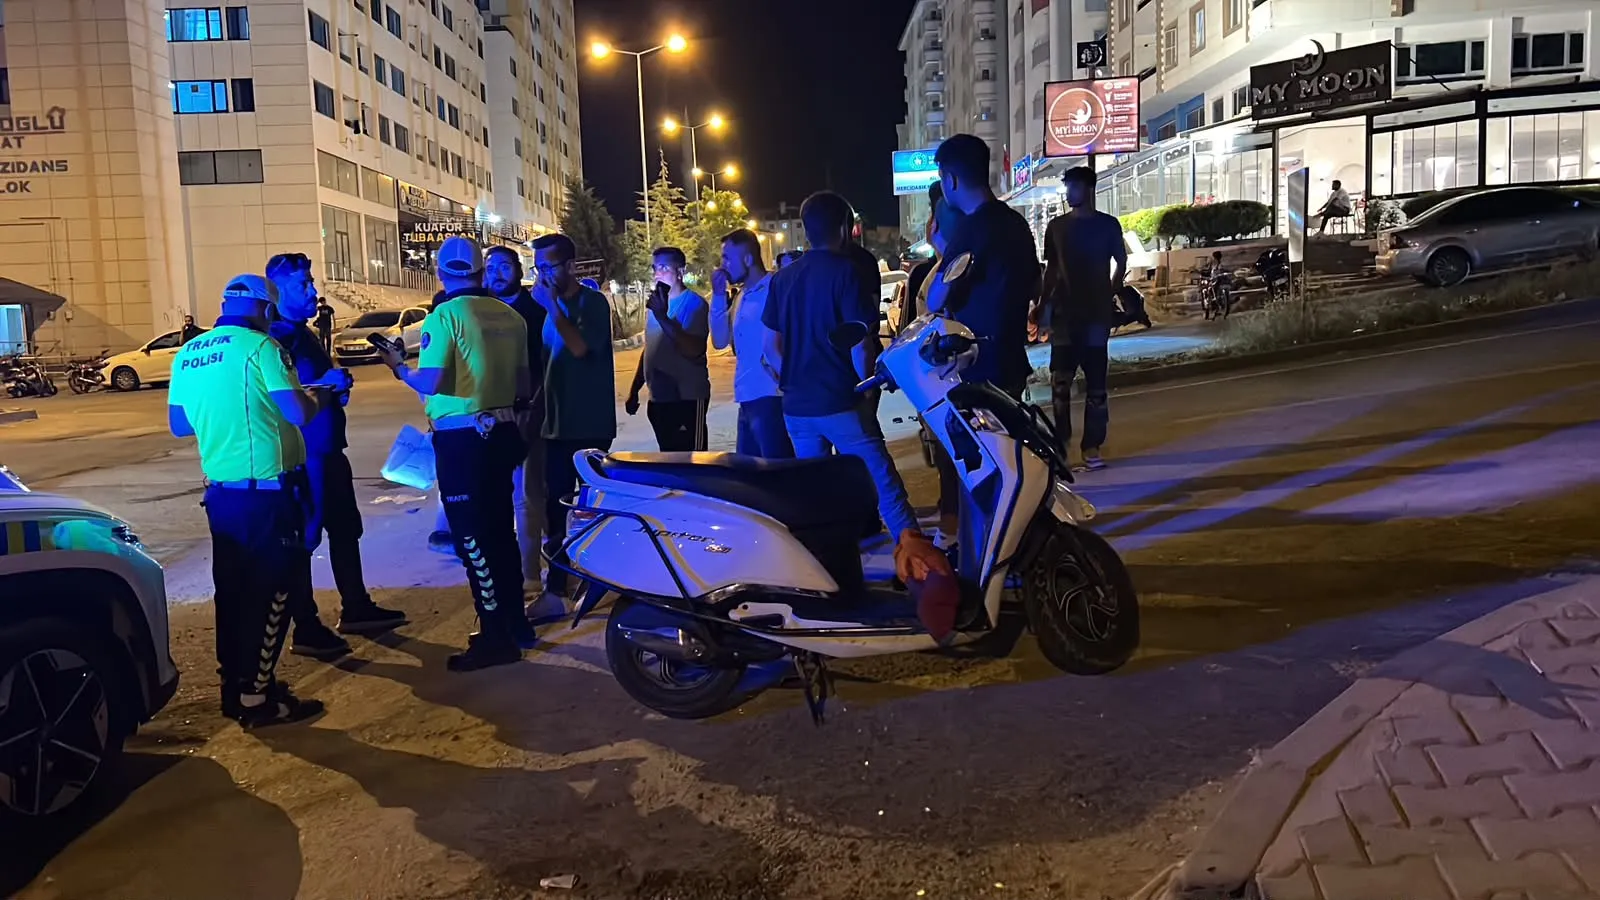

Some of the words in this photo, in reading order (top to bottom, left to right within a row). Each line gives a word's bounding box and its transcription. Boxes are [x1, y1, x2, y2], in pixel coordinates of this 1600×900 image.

[1252, 80, 1292, 106] MY
[1299, 64, 1385, 98] MOON
[1072, 123, 1098, 134] MOON
